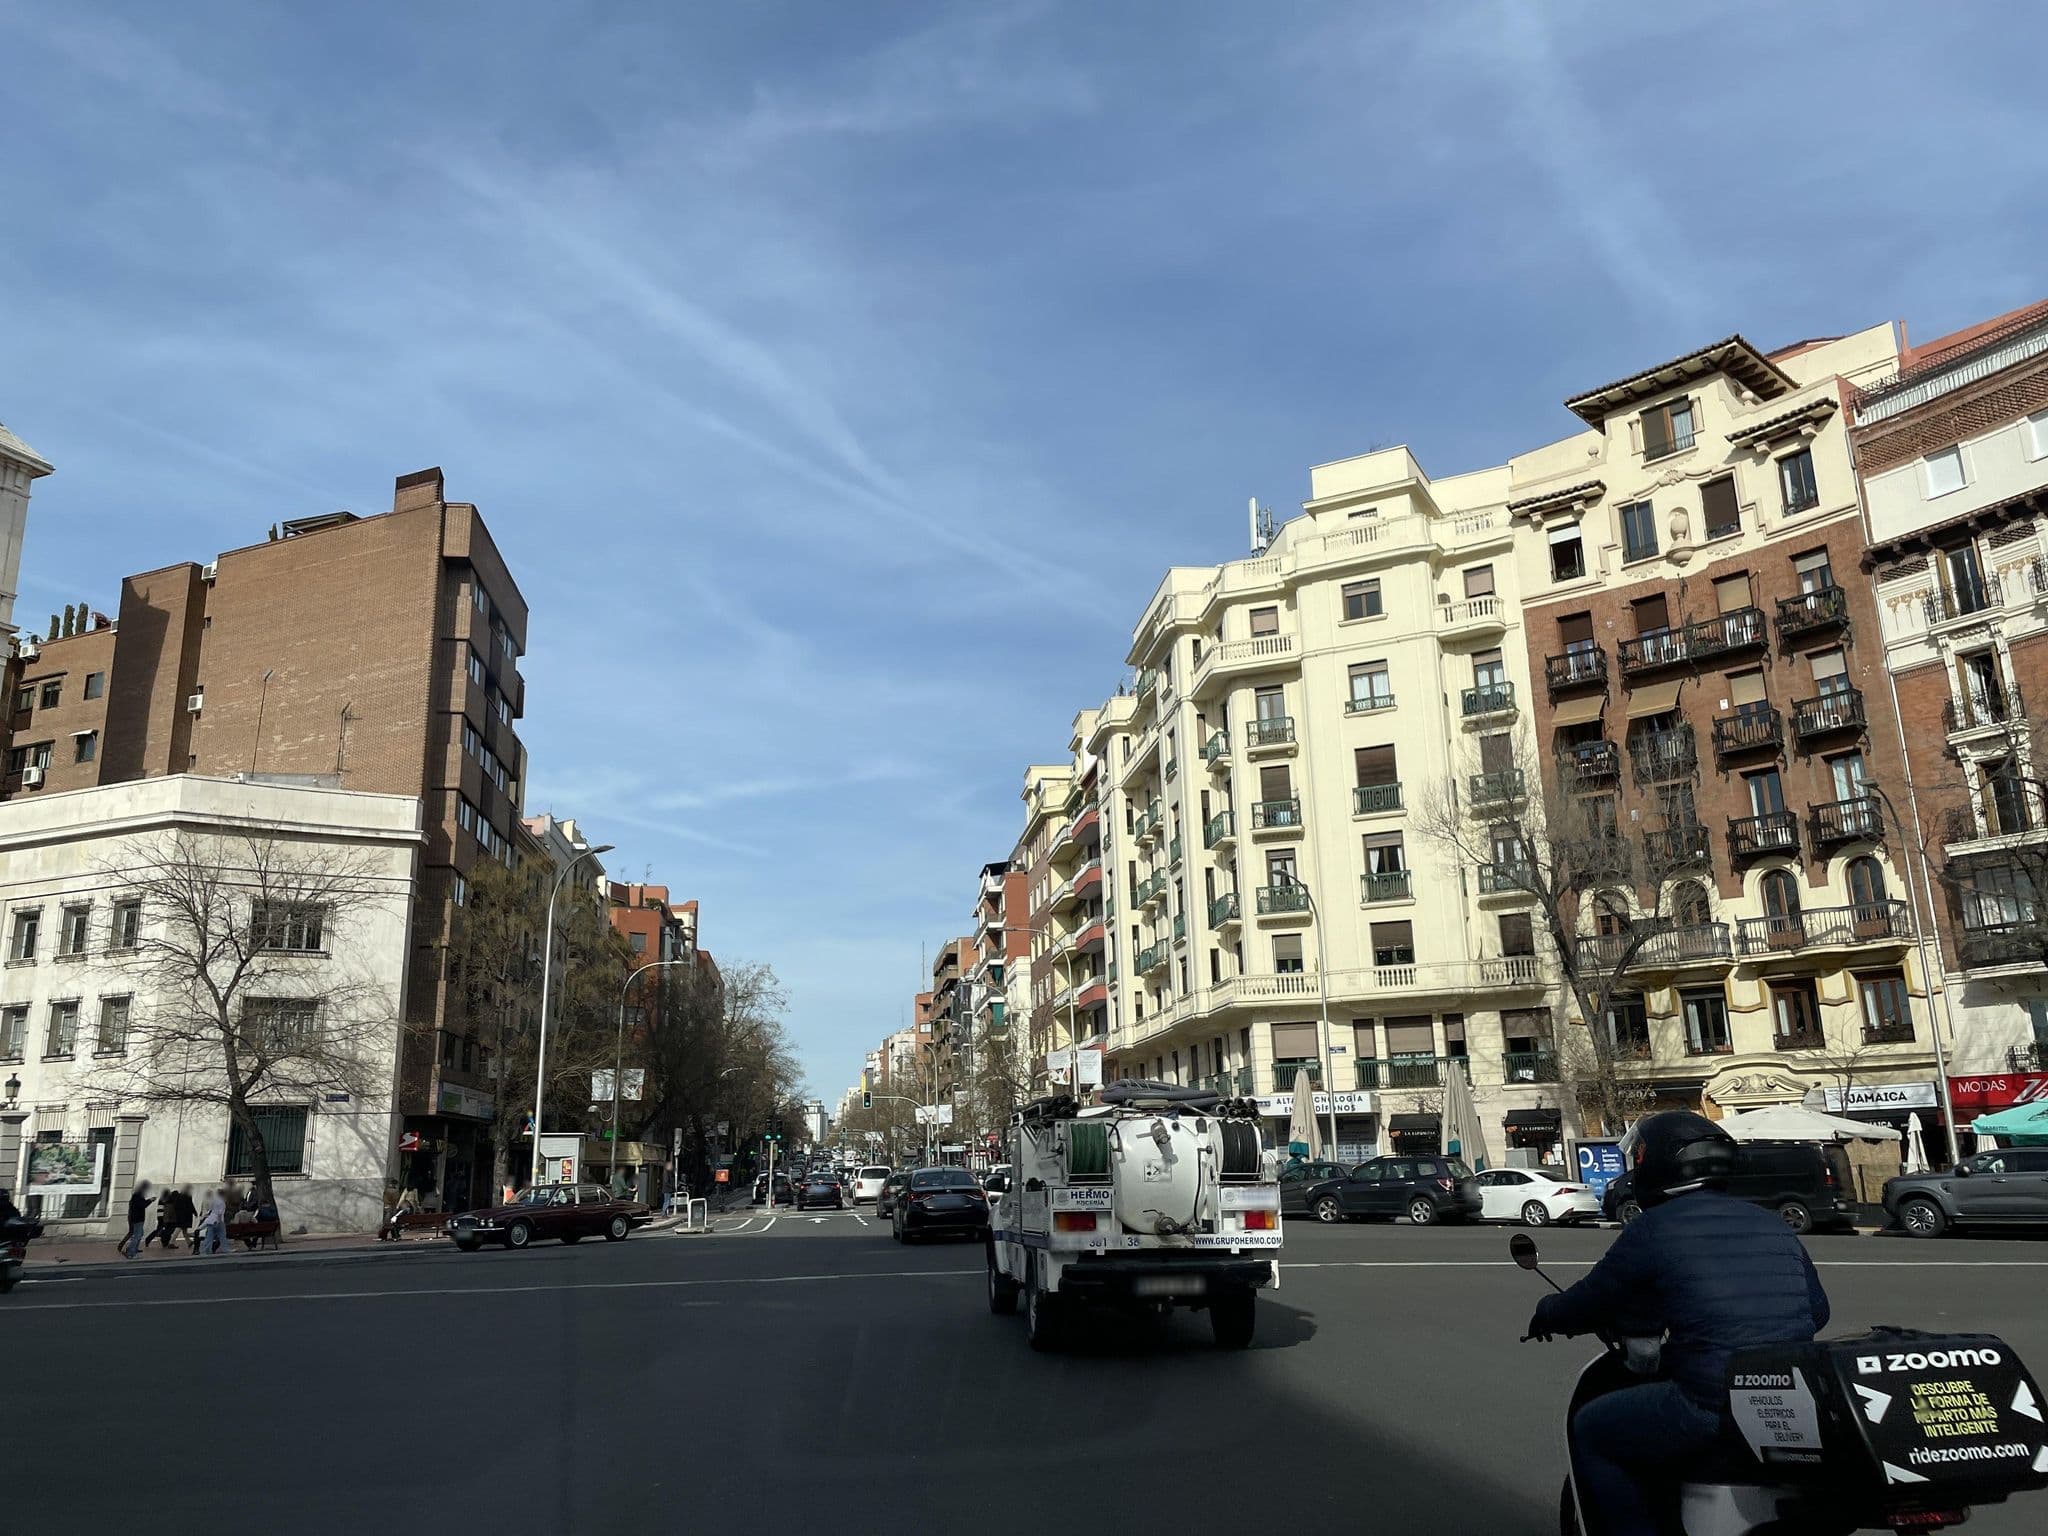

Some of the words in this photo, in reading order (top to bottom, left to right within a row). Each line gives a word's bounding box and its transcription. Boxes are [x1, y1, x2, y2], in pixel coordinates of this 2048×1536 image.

[1958, 1079, 2007, 1093] MODAS
[1849, 1091, 1908, 1104] JAMAICA
[1070, 1190, 1110, 1199] HERMO
[1195, 1236, 1282, 1245] WWW.GRUPOHERMO.COM
[1886, 1348, 2002, 1372] zoomo
[1745, 1374, 1792, 1386] zoomo
[1911, 1380, 1976, 1396] DESCUBRE
[1929, 1395, 1972, 1409] FORMA
[1973, 1393, 1991, 1406] DE
[1923, 1420, 2000, 1439] INTELIGENTE
[1909, 1442, 2031, 1465] ridezoomo.com
